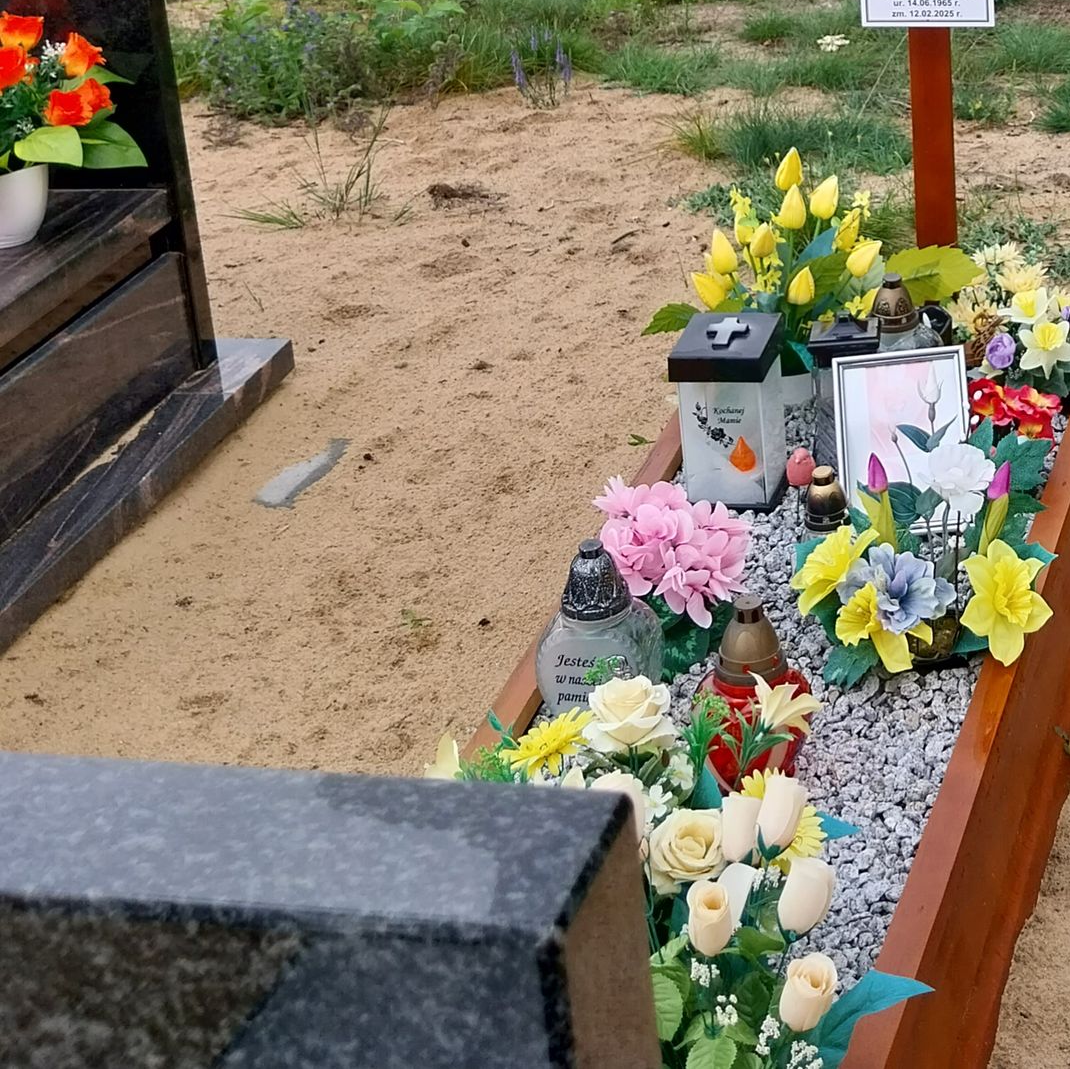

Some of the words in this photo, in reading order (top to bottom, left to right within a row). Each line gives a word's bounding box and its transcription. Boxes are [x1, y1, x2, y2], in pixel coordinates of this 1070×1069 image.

[713, 406, 745, 416] Kochanej
[555, 654, 596, 668] Jesteś
[555, 674, 567, 684] w
